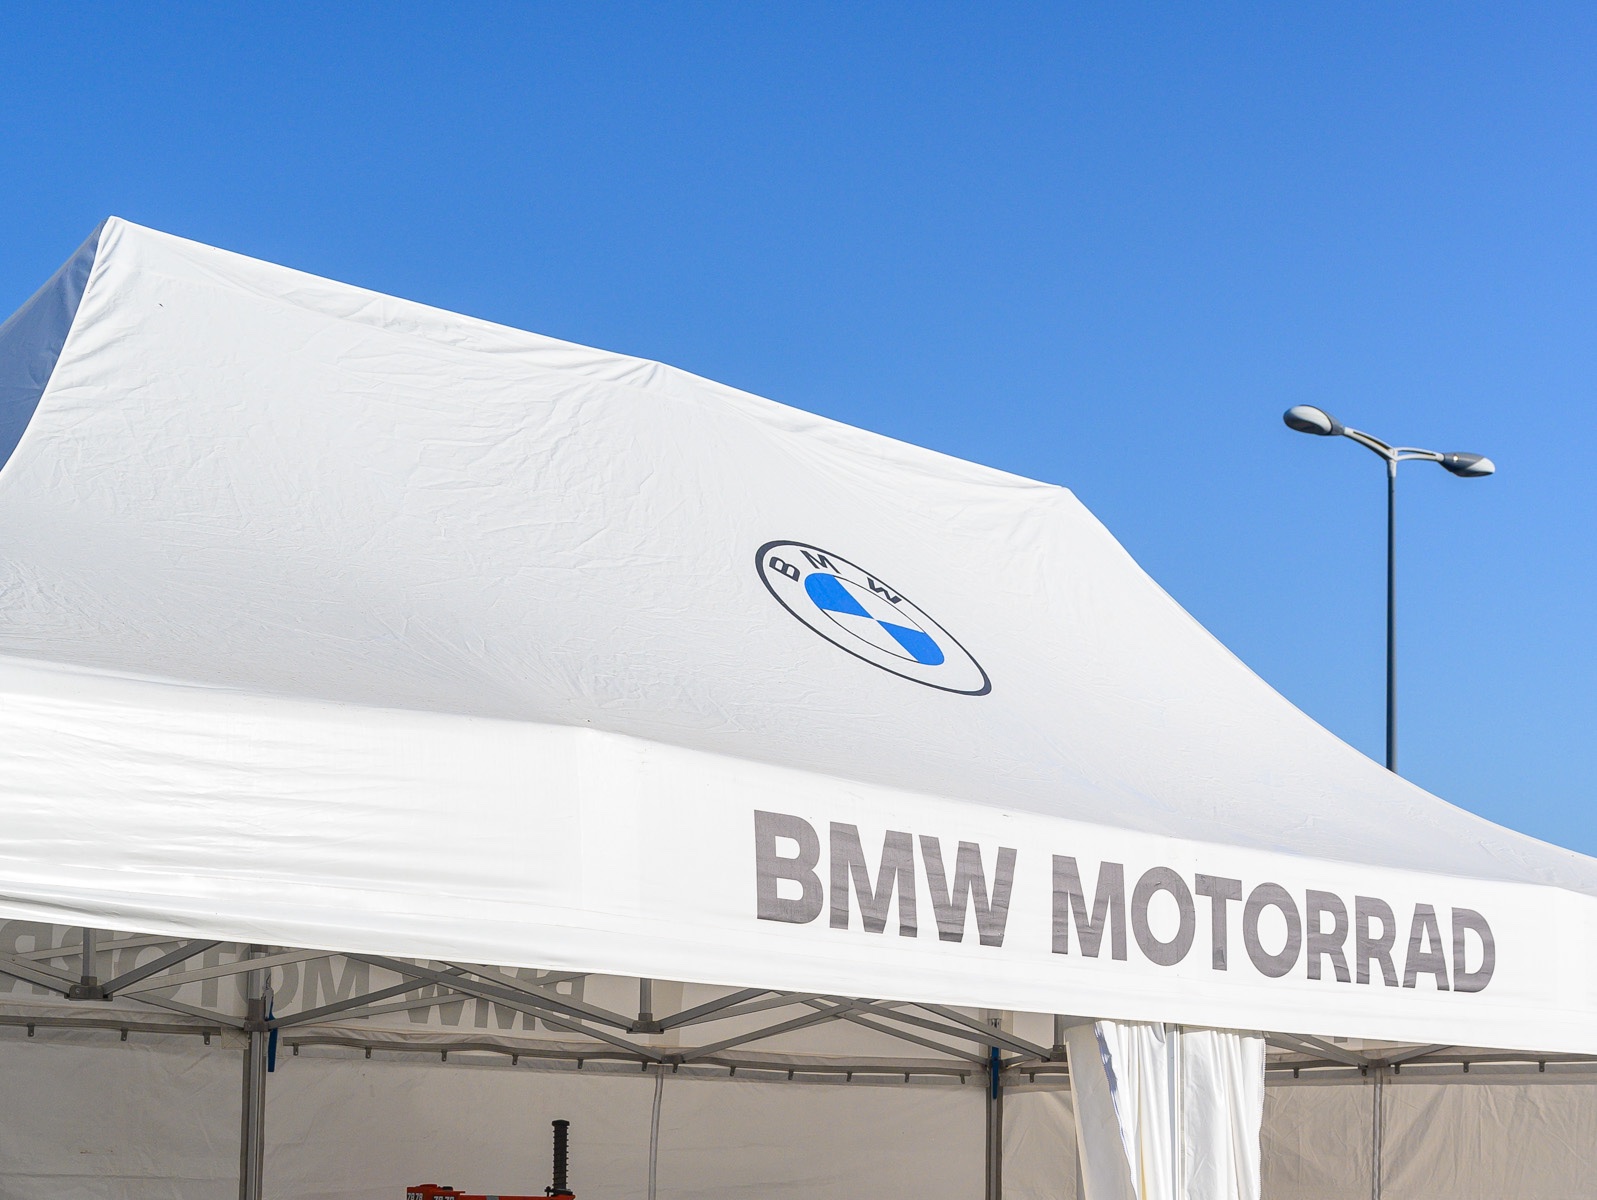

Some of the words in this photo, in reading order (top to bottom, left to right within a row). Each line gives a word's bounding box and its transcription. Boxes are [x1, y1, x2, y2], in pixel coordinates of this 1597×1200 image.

[769, 548, 903, 604] BMW
[753, 809, 1017, 948] BMW
[1052, 853, 1497, 994] MOTORRAD
